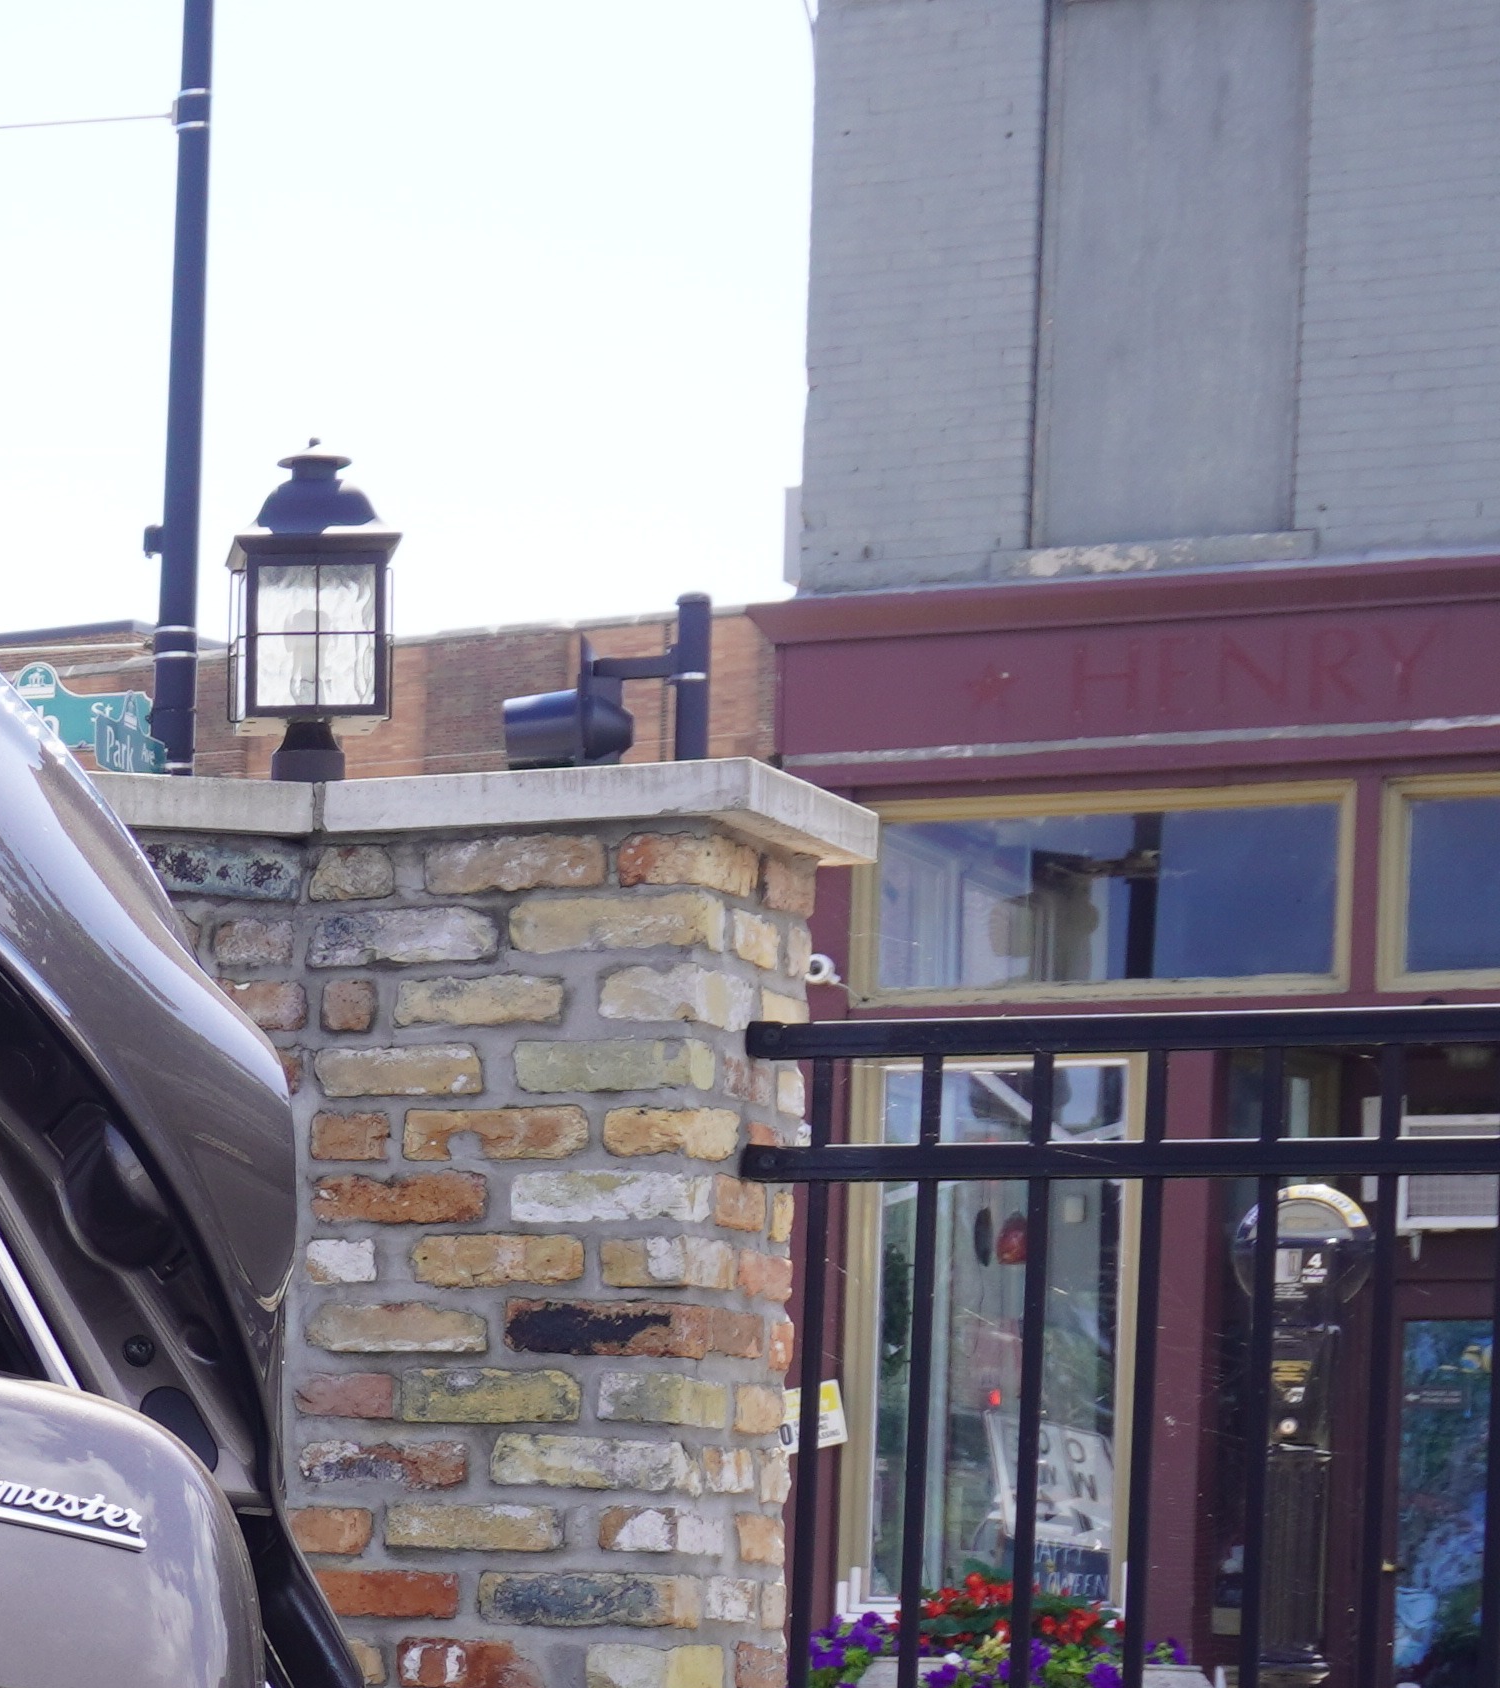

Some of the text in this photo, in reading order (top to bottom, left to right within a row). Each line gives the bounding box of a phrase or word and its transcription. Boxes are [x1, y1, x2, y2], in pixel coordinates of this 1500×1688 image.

[1071, 624, 1451, 716] HENRY
[106, 725, 135, 773] Park
[141, 742, 156, 767] Ave
